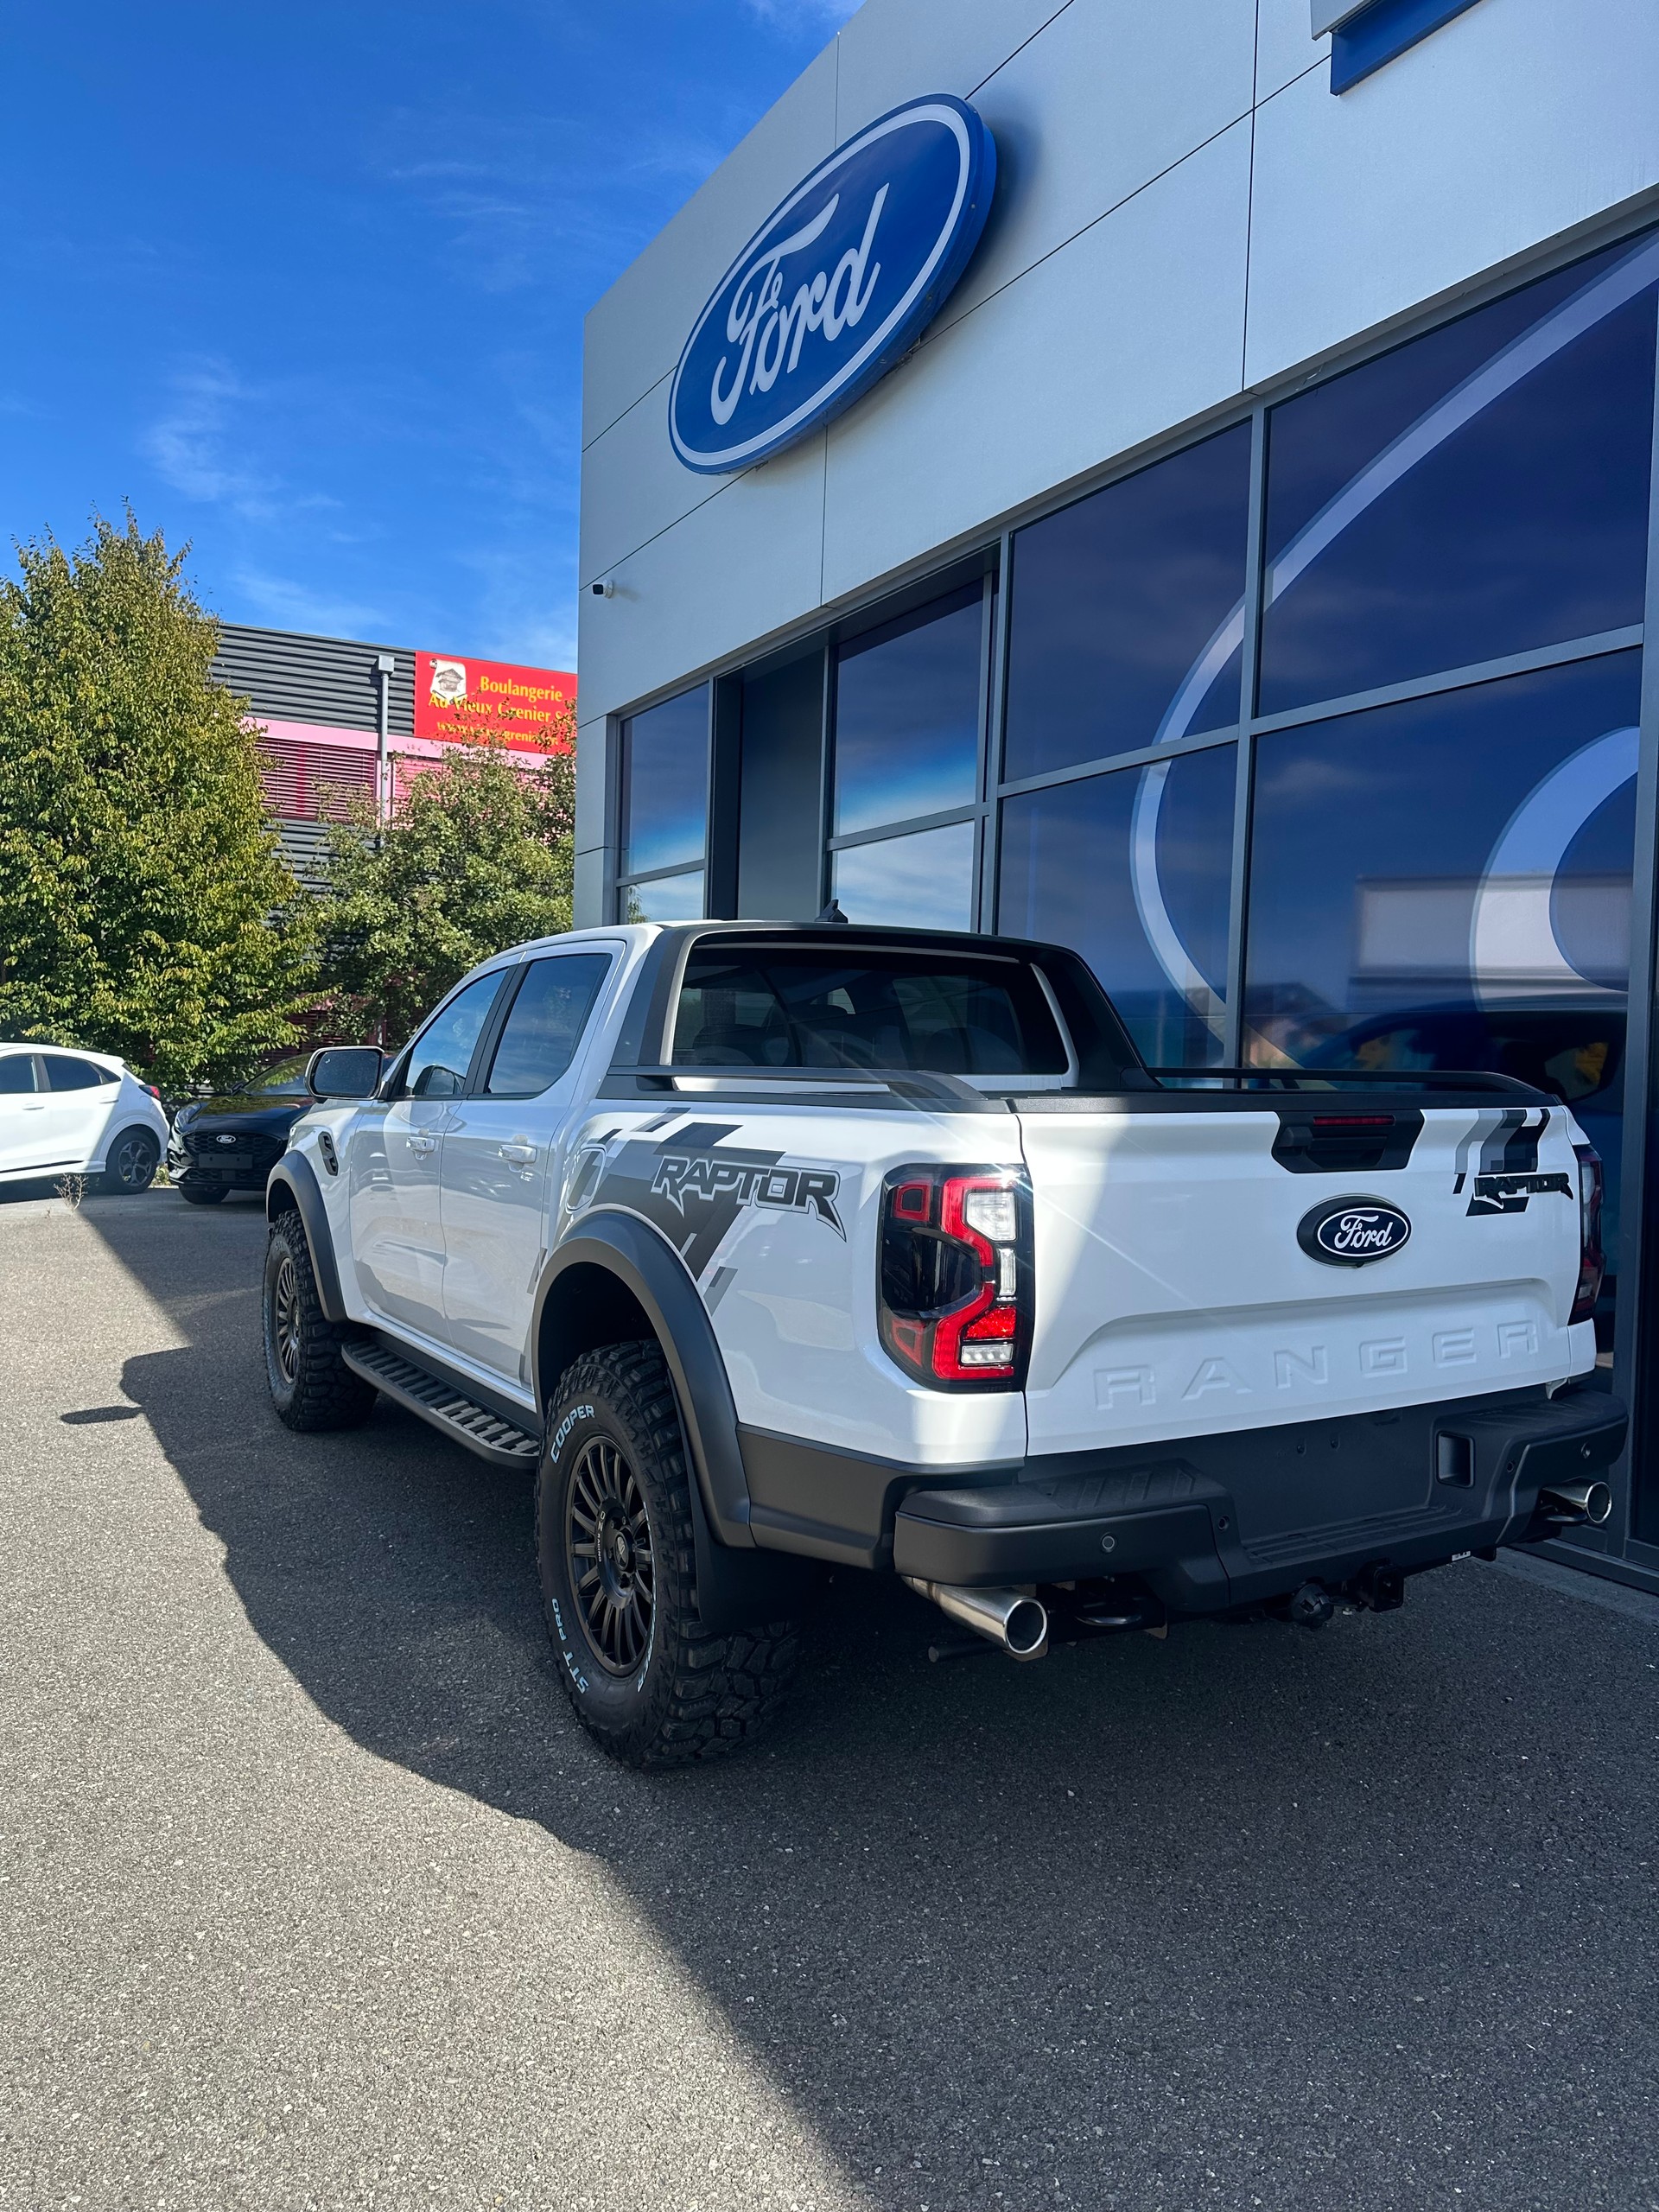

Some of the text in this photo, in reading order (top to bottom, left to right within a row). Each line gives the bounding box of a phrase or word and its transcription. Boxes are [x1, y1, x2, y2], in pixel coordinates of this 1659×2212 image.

[710, 182, 890, 426] Ford
[429, 692, 448, 709] Au
[454, 695, 493, 715] Vieux
[480, 676, 563, 703] Boulangerie
[651, 1155, 847, 1243] RAPTOR
[1474, 1173, 1574, 1209] RAPTOR
[1334, 1215, 1394, 1249] Ford
[1093, 1320, 1538, 1410] RANGER
[550, 1404, 595, 1464] COOPER
[552, 1598, 589, 1694] STT PRO
